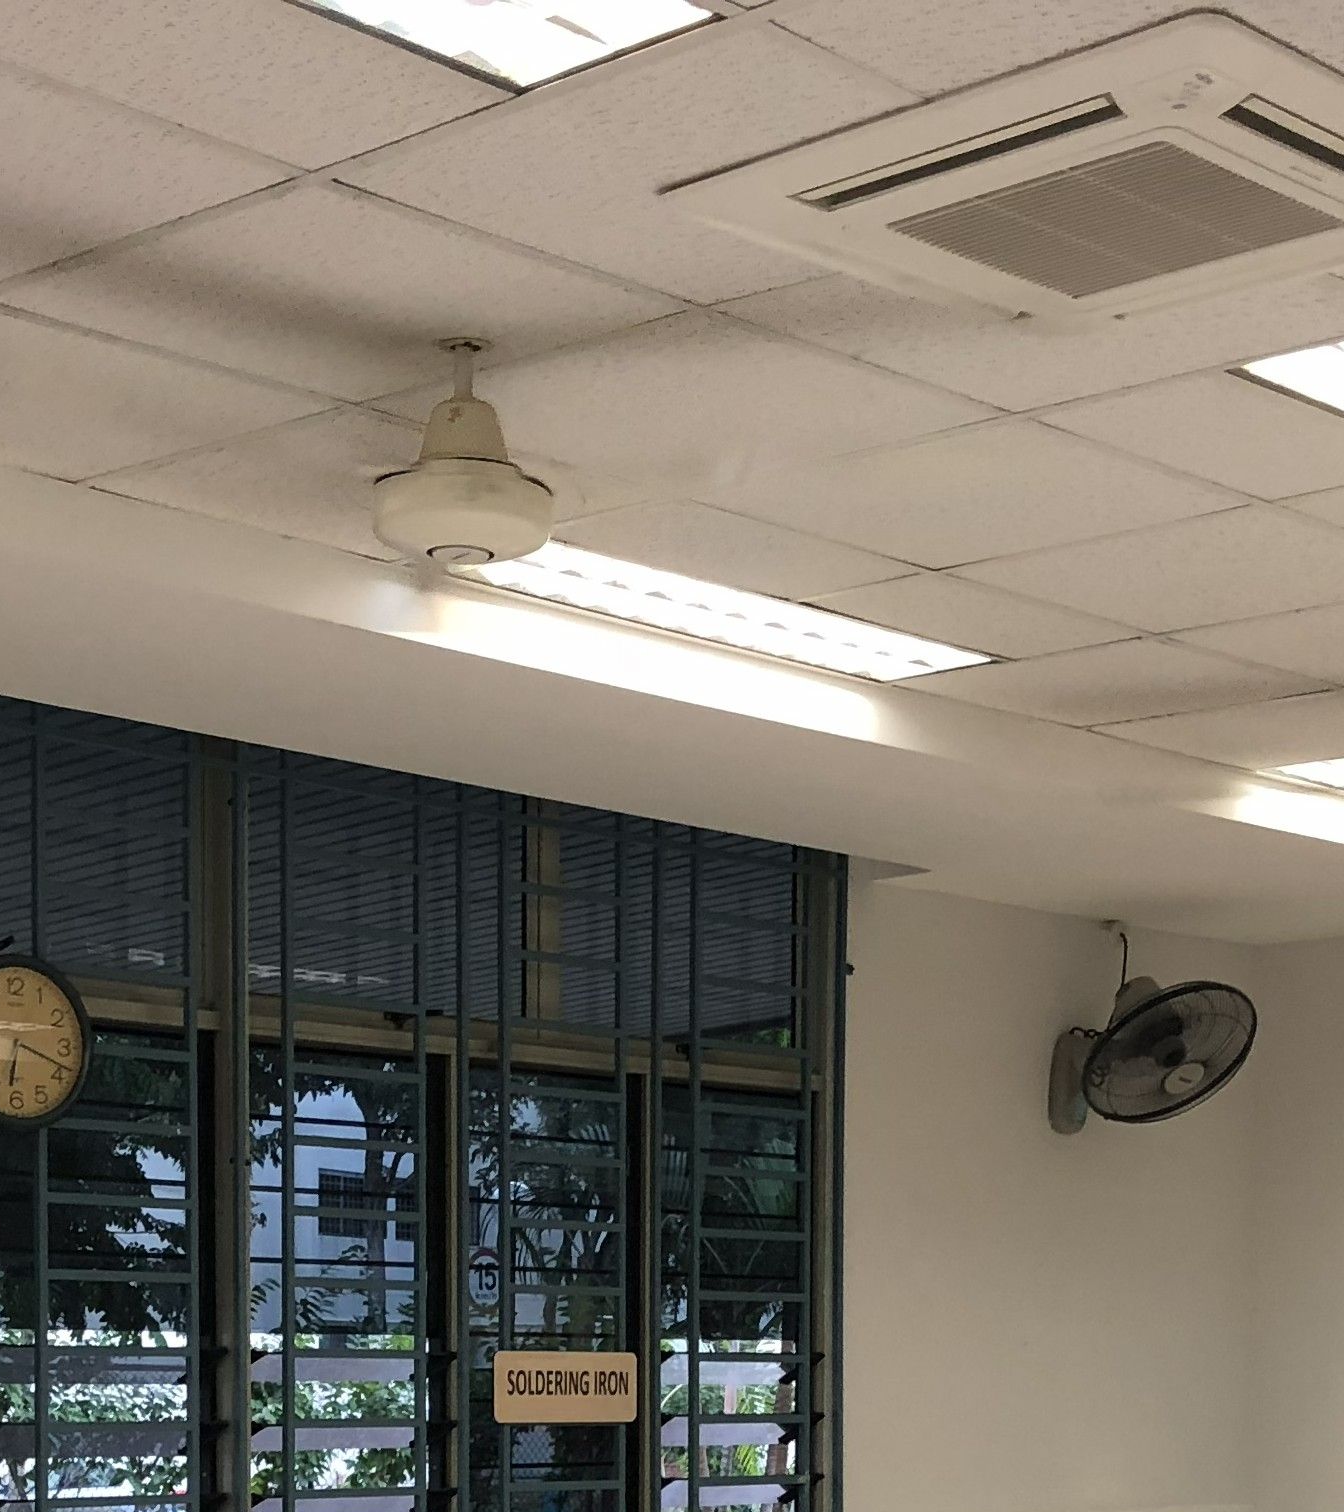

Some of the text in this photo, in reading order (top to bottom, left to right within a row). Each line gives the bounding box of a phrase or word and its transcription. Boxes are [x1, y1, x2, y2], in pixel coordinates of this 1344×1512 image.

[7, 977, 25, 996] 12
[36, 986, 44, 1004] 1
[50, 1008, 65, 1028] 2
[57, 1037, 72, 1057] 3
[50, 1067, 67, 1085] 4
[9, 1091, 25, 1110] 6
[33, 1085, 49, 1104] 5
[507, 1369, 630, 1396] SOLDERING IRON
